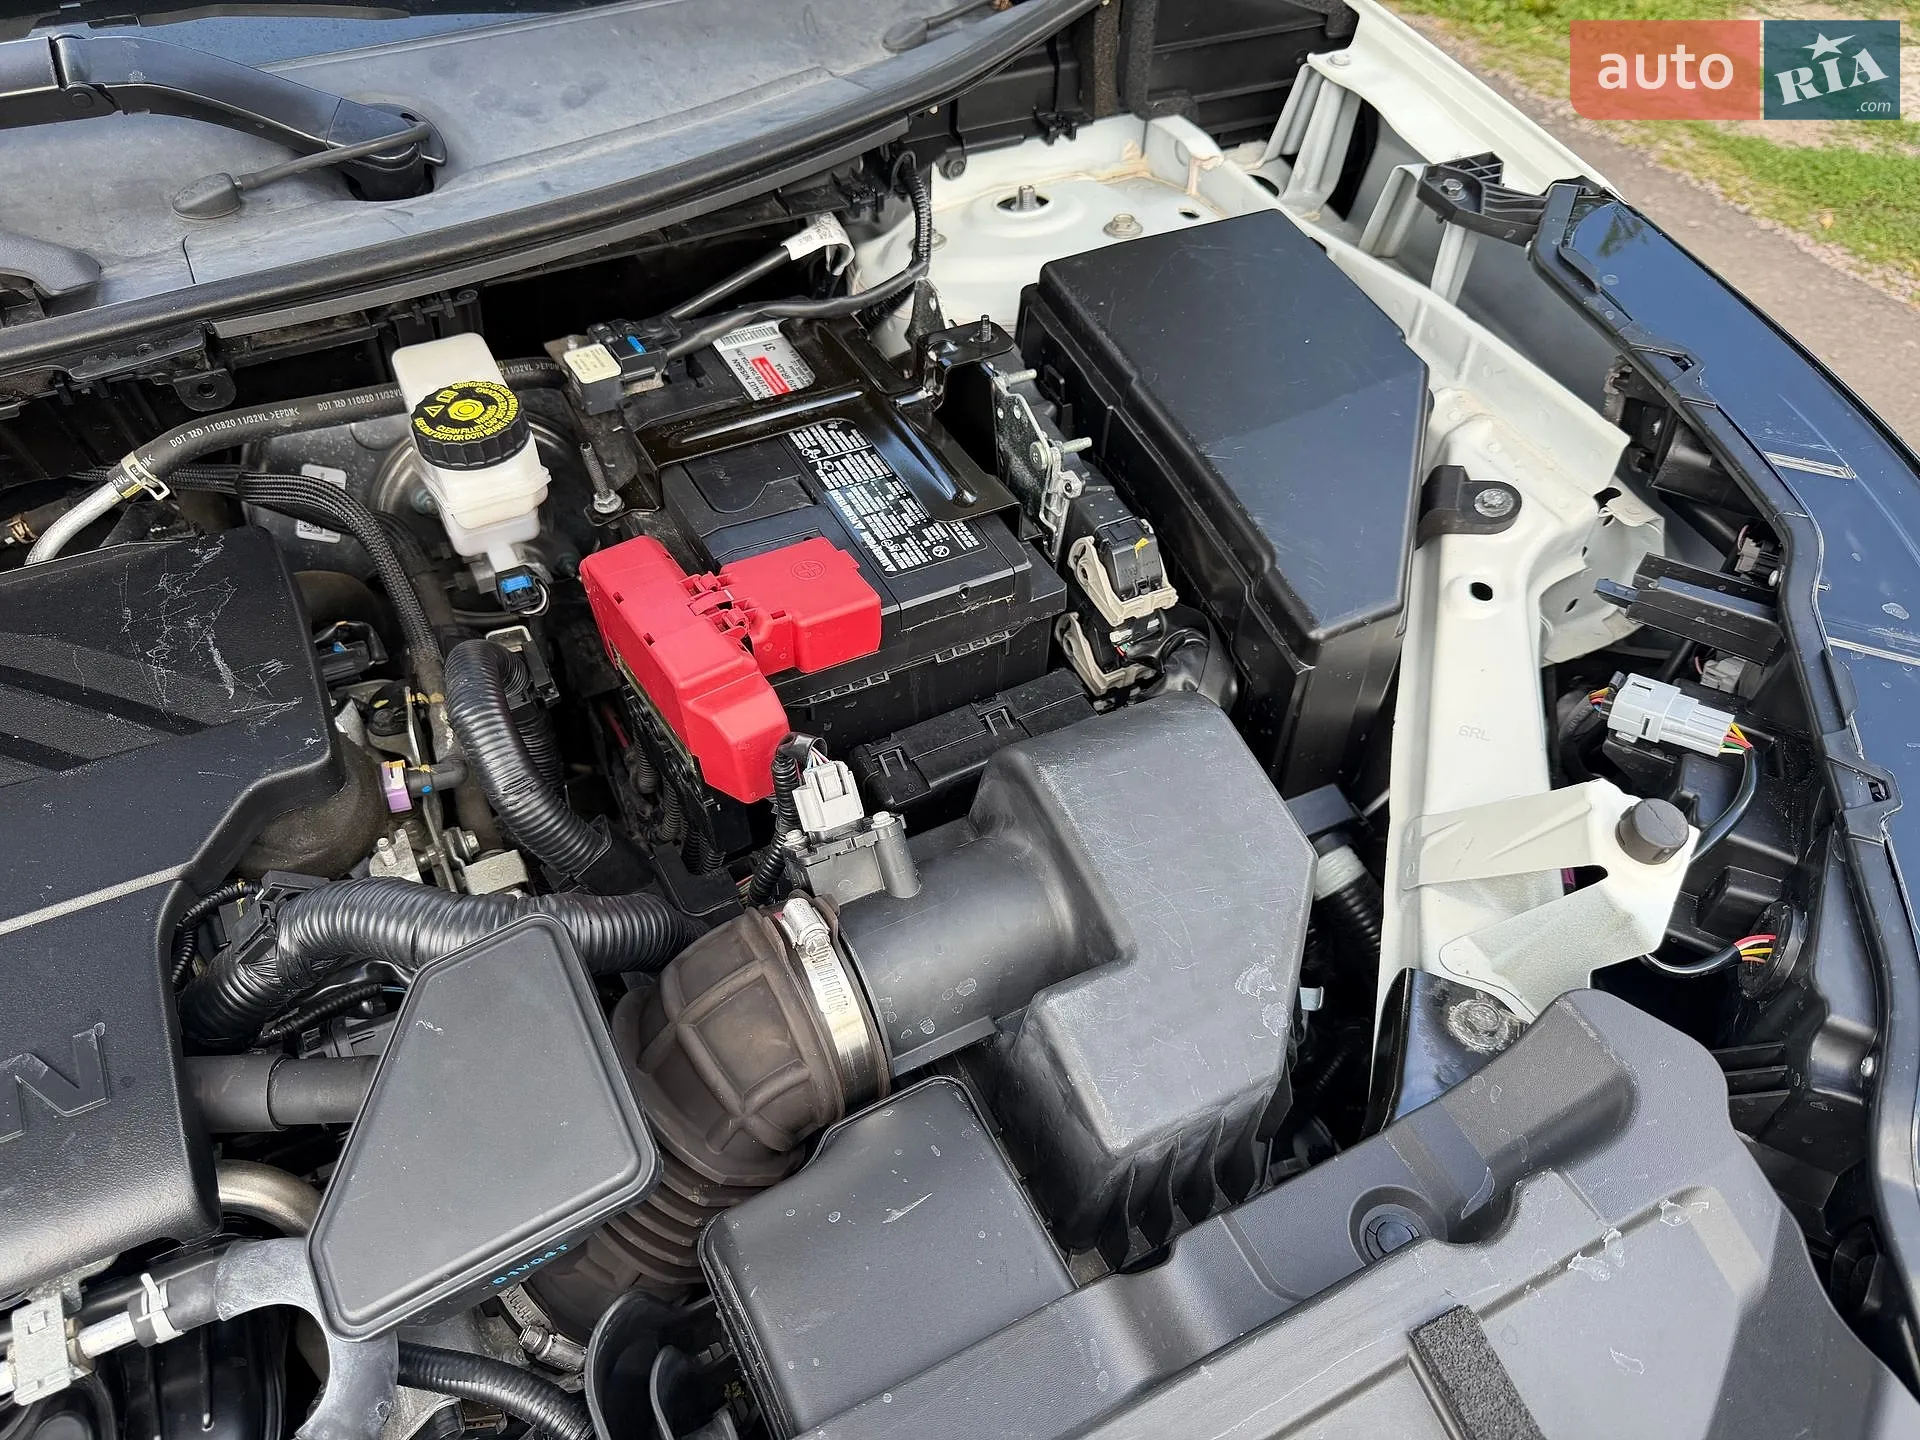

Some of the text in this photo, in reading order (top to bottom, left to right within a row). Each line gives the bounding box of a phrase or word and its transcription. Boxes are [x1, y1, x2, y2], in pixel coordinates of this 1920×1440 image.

[732, 359, 751, 380] NISSAN
[317, 402, 332, 411] DOT
[347, 394, 375, 406] 110820
[169, 434, 187, 448] DOT
[204, 419, 236, 433] 110820
[237, 413, 269, 425] 11/32VL
[269, 407, 300, 420] >EPDM<
[460, 425, 484, 434] FILLER
